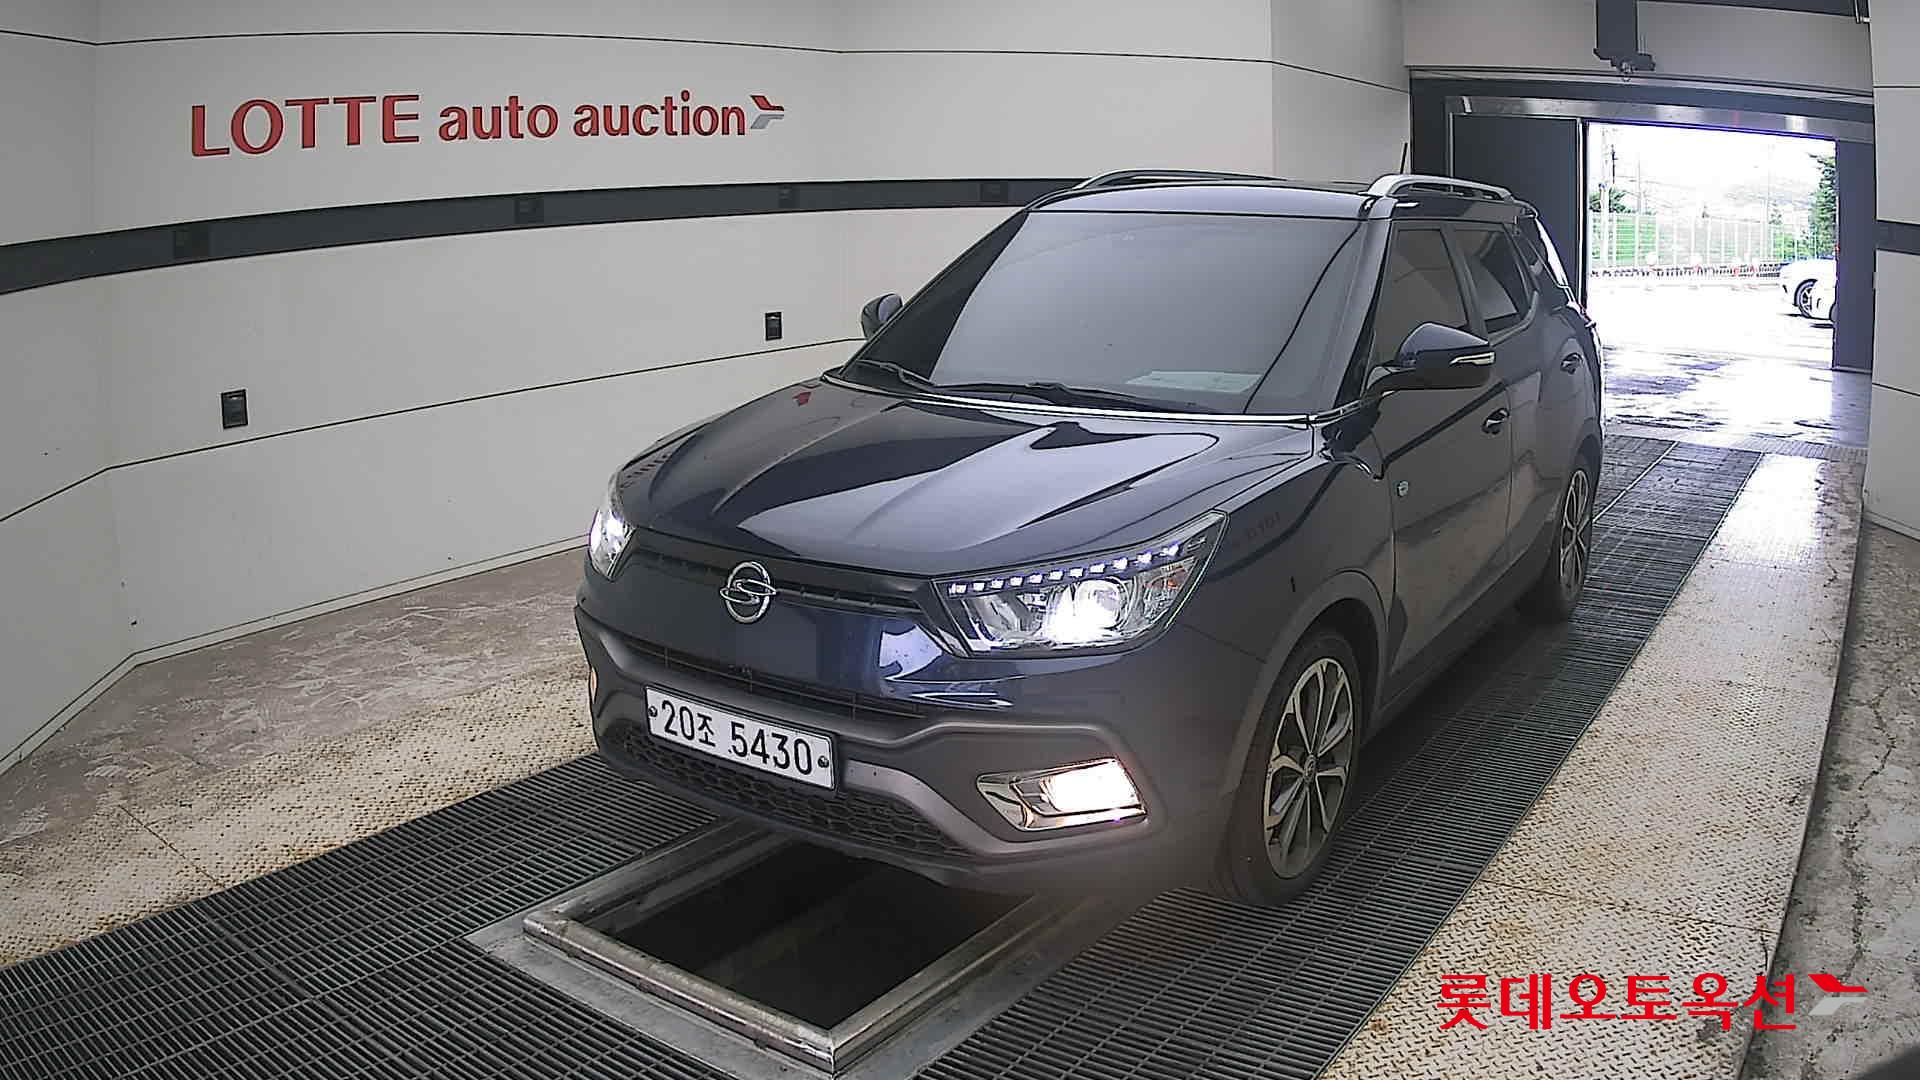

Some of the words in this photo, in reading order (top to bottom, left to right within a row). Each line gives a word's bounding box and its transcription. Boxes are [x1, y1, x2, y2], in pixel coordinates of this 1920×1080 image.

[191, 94, 420, 156] LOTTE
[438, 95, 559, 141] auto
[573, 90, 747, 137] auction
[661, 699, 716, 748] 20조
[730, 720, 813, 776] 5430
